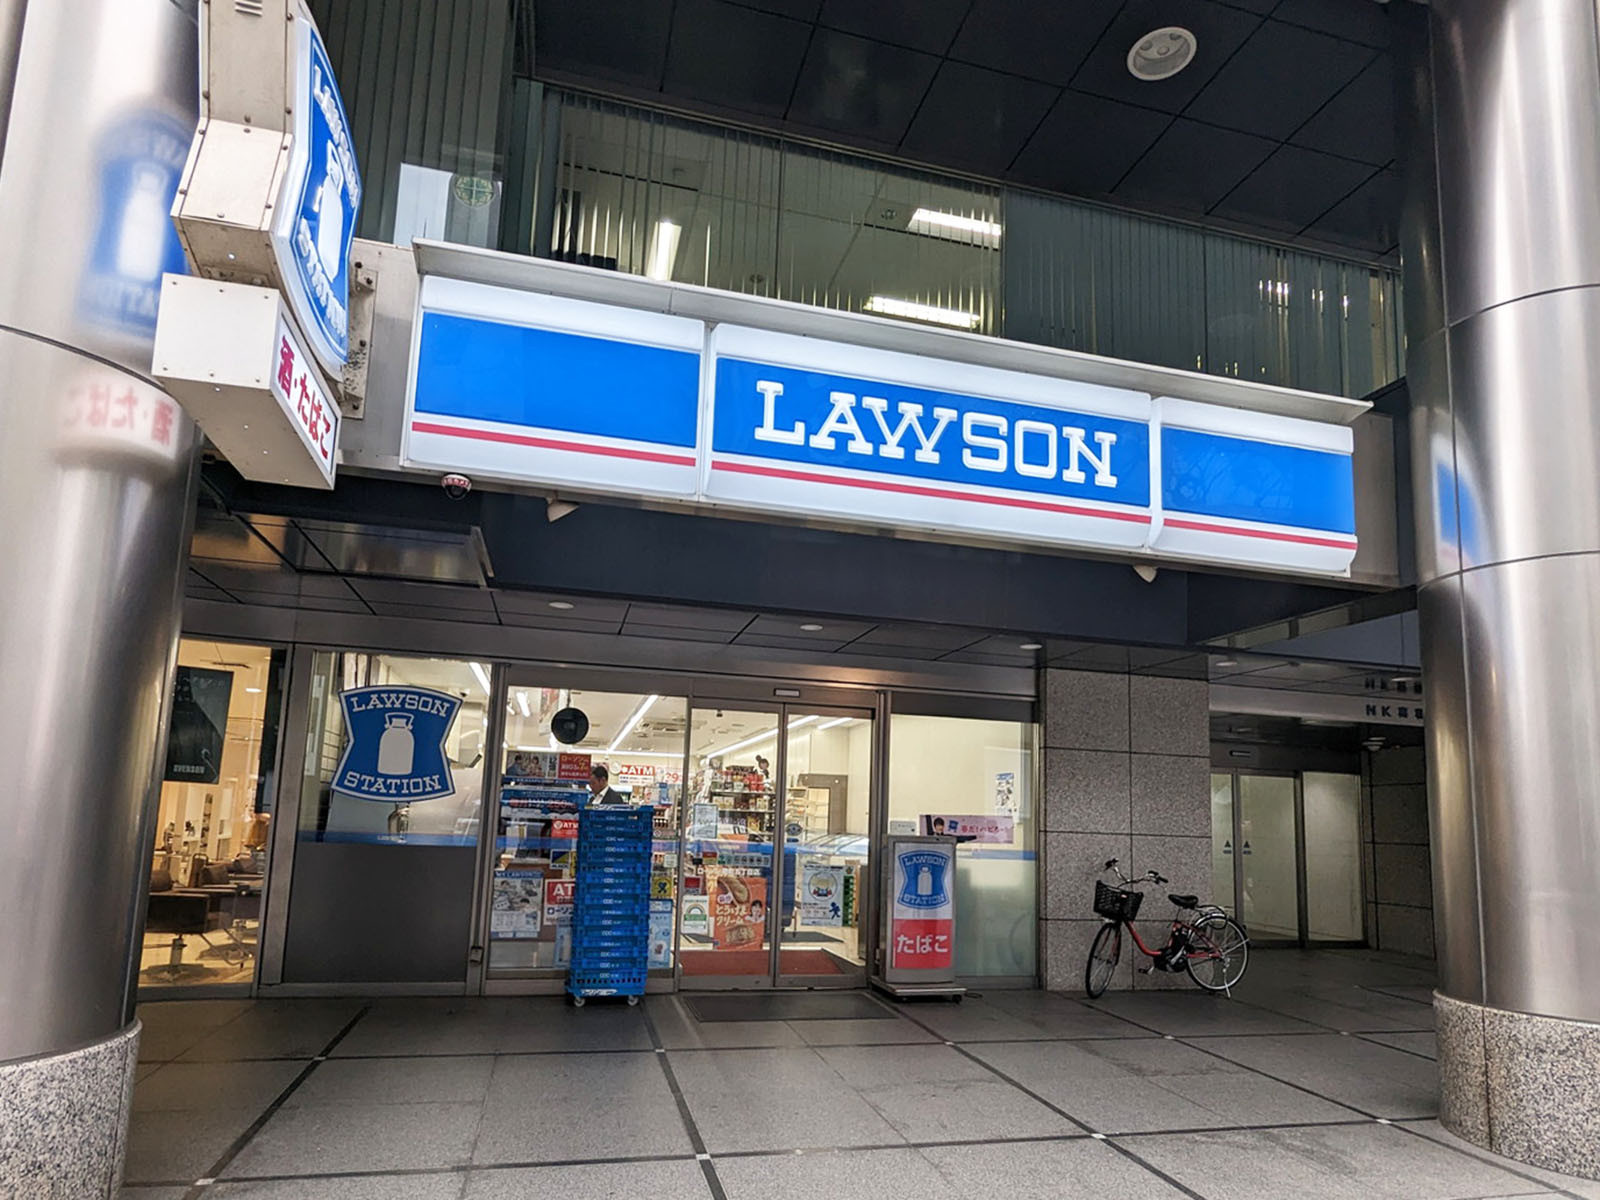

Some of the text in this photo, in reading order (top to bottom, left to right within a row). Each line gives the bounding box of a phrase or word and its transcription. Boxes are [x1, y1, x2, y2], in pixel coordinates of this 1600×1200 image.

[278, 335, 331, 460] 酒・たばこ
[754, 380, 1119, 488] LAWSON
[350, 693, 450, 717] LAWSON
[628, 766, 653, 776] ATM
[344, 771, 442, 794] STATION
[904, 855, 946, 867] LAWSON
[552, 883, 576, 896] AT
[903, 893, 945, 906] STATION
[896, 934, 948, 954] たばこ
